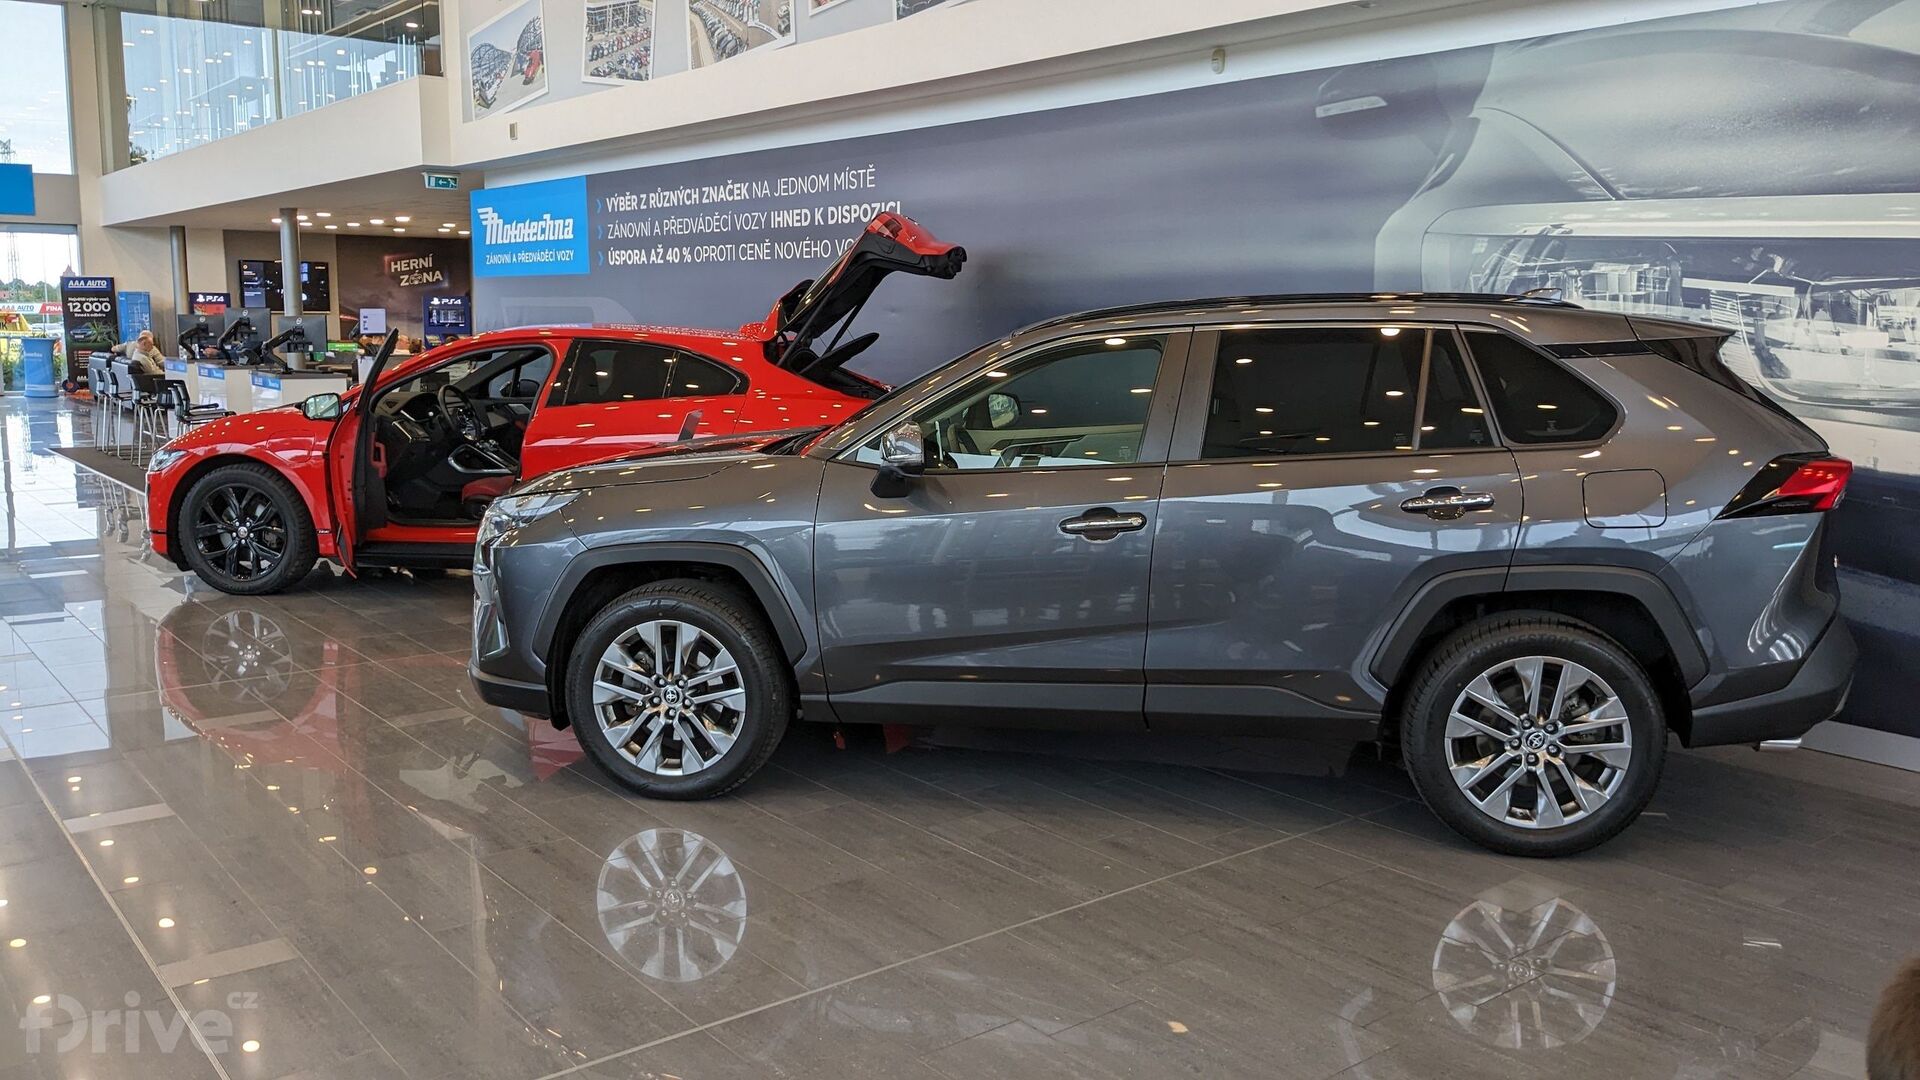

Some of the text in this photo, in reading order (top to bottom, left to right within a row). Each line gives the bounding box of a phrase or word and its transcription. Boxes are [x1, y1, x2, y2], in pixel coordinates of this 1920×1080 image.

[606, 164, 876, 213] VÝBĚR Z RŮZNÝCH ZNAČEK NA JEDNOM MÍSTĚ
[479, 207, 574, 245] Mototechna
[607, 218, 651, 239] ZÁNOVNÍ
[653, 220, 661, 236] A
[664, 211, 732, 235] PŘEDVÁDĚCÍ
[734, 212, 768, 230] VOZY
[770, 208, 811, 228] IHNED
[814, 207, 825, 226] K
[486, 249, 574, 264] ZÁNOVNÍ A PŘEDVÁDĚCÍ VOZY
[608, 245, 647, 266] ÚSPORA
[649, 244, 664, 264] AŽ
[666, 247, 680, 264] 40
[682, 247, 692, 263] %
[694, 244, 736, 263] OPROTI
[738, 239, 772, 261] CENĚ
[774, 236, 832, 260] NOVÉHO
[391, 254, 433, 273] HERNÍ
[68, 280, 107, 288] AAA AUTO
[68, 302, 111, 312] 12 000
